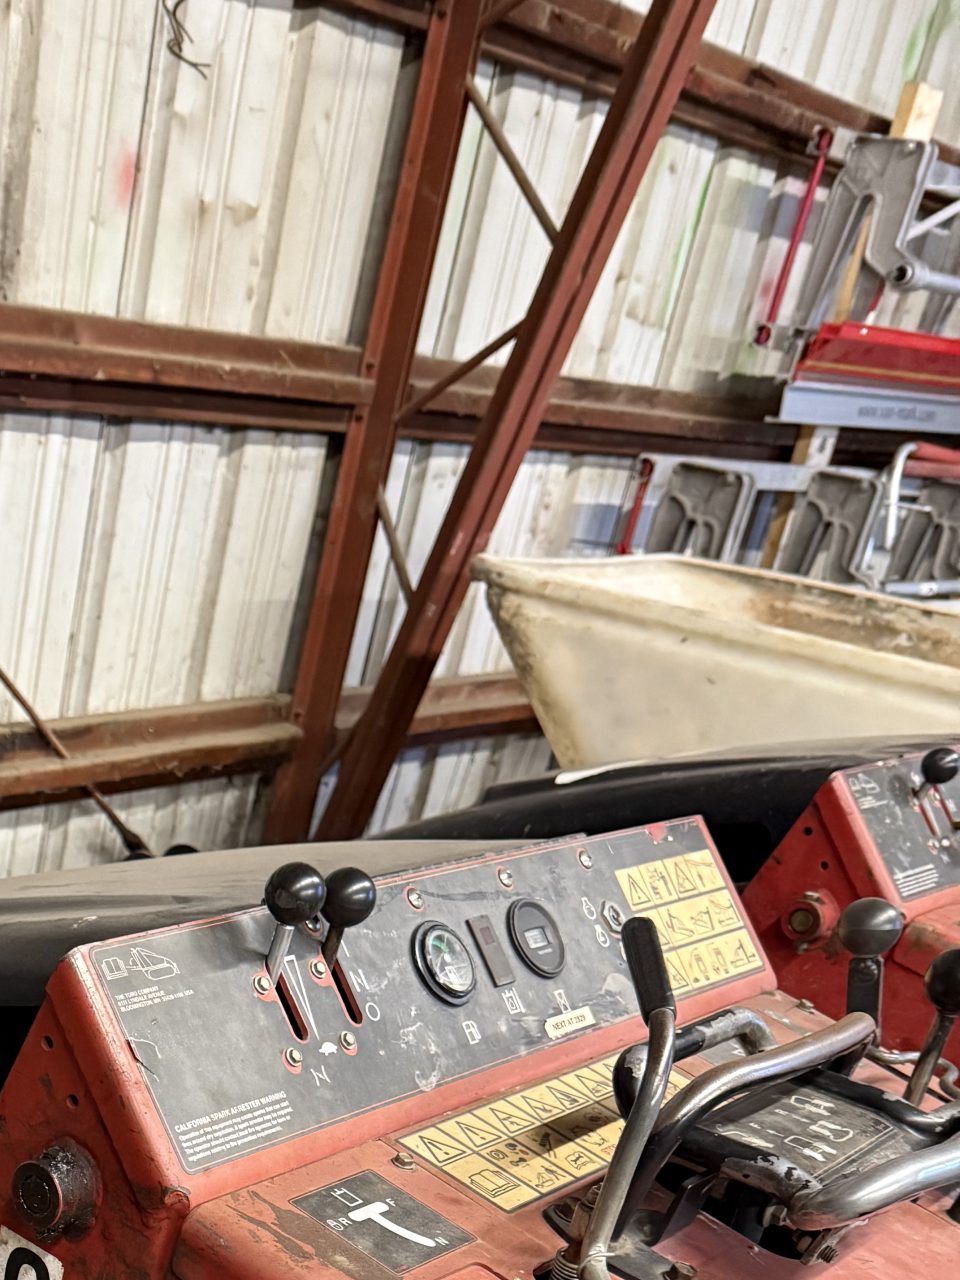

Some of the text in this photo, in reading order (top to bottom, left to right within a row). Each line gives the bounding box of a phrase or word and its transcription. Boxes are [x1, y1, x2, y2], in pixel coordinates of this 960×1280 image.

[174, 1115, 211, 1133] CALIFORNIA
[210, 1108, 231, 1121] SPARK
[259, 1090, 287, 1105] WARNING
